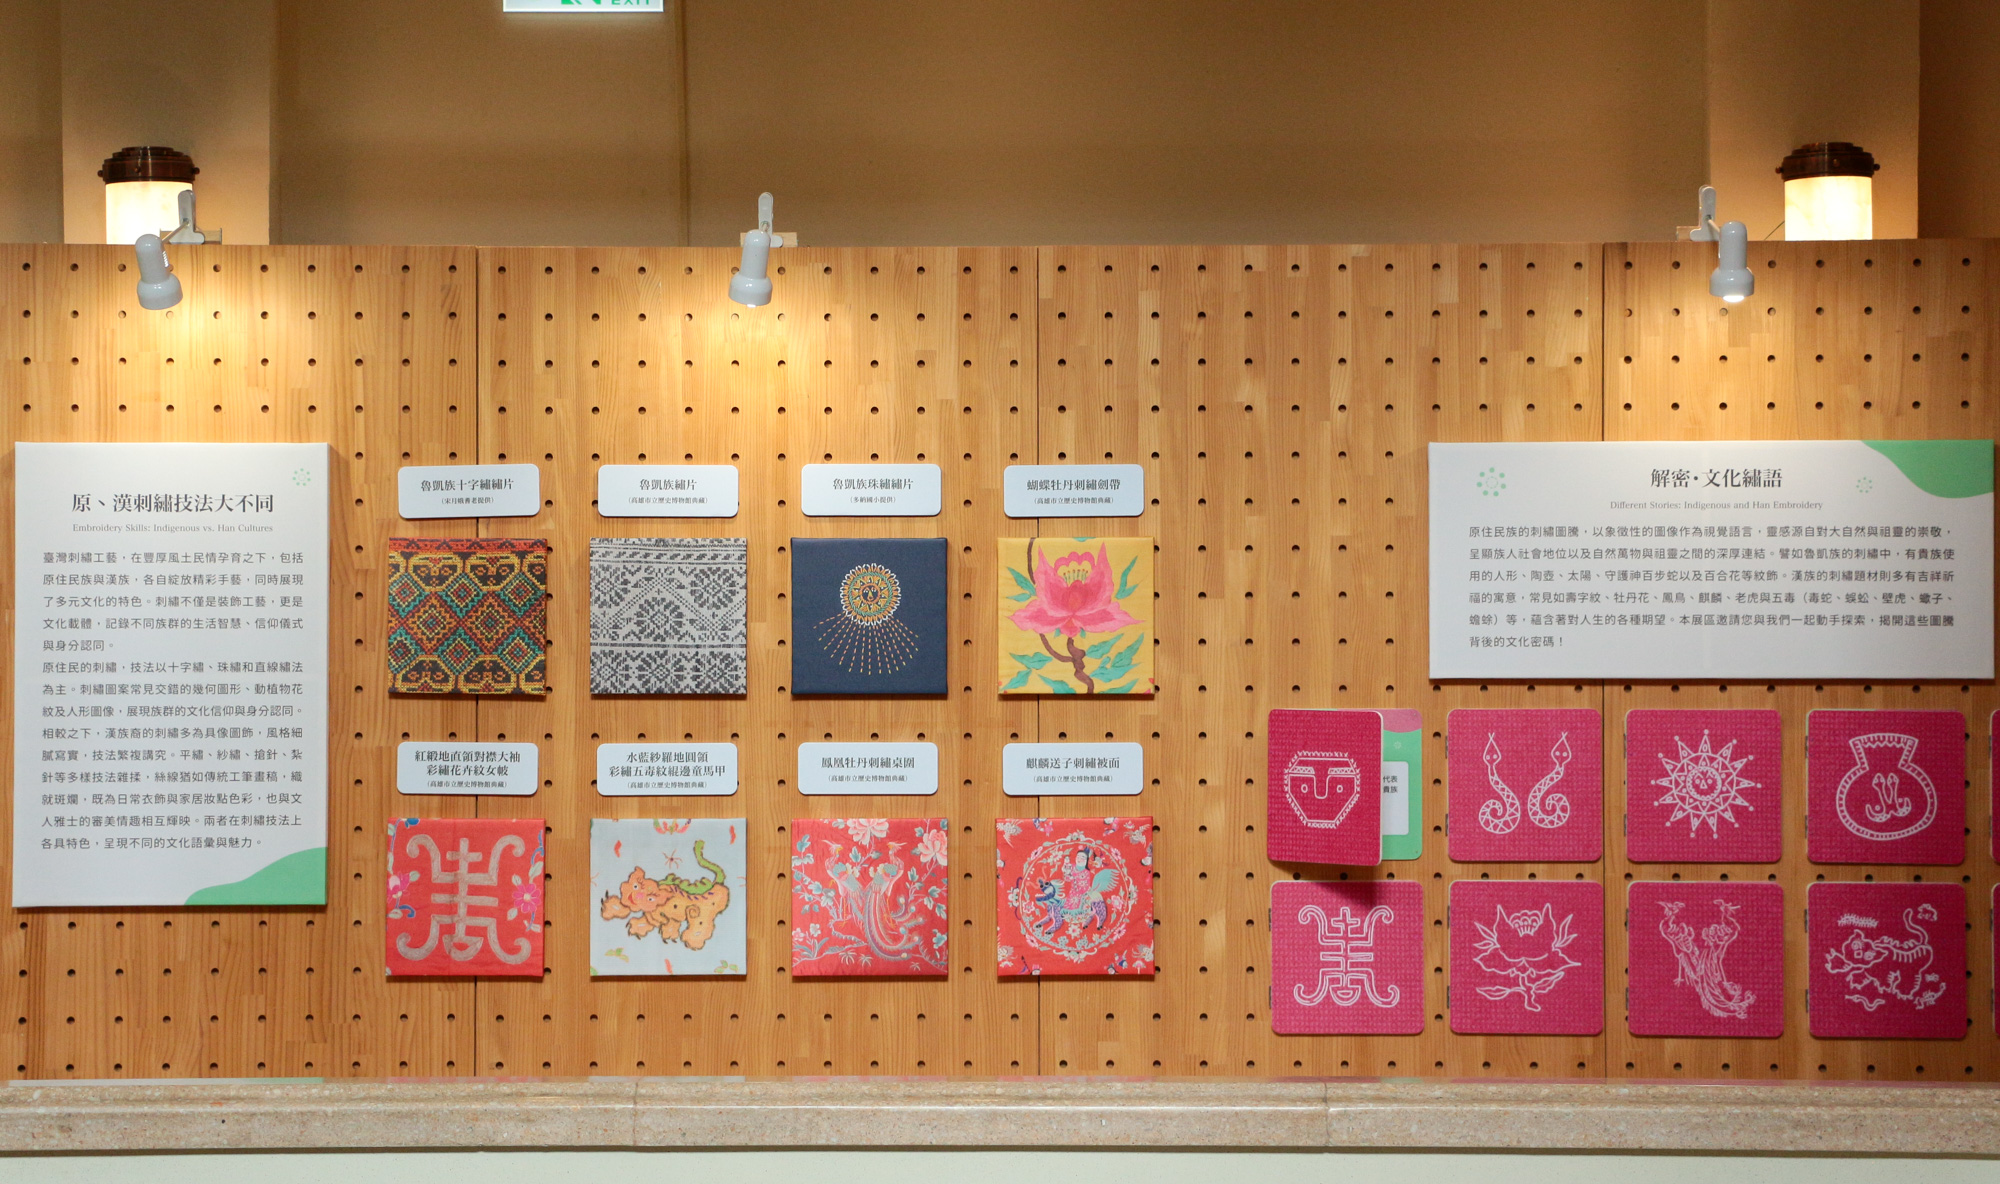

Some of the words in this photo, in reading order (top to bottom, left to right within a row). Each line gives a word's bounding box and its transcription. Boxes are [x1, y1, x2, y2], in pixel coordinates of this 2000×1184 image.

[420, 478, 515, 492] 魯凱族十字繡繡片
[639, 478, 698, 491] 魯凱族繡片
[832, 478, 914, 490] 魯凱族珠繡繡片
[1026, 478, 1121, 491] 蝴蝶牡丹刺繡劍帶
[72, 493, 274, 513] 原、漢刺繡技法大不同
[1610, 501, 1647, 510] Different
[1649, 501, 1681, 510] Stories:
[1683, 501, 1731, 511] Indigenous
[1733, 501, 1750, 510] and
[1752, 501, 1771, 510] Han
[1773, 501, 1823, 511] Embroidery
[72, 524, 123, 533] Embroidery
[125, 524, 151, 532] Skills:
[153, 524, 200, 533] Indigenous
[202, 524, 215, 532] vs.
[217, 524, 236, 532] Han
[238, 524, 274, 532] Cultures
[43, 639, 114, 652] 與身分認同。
[1469, 636, 1563, 648] 背後的文化密碼！
